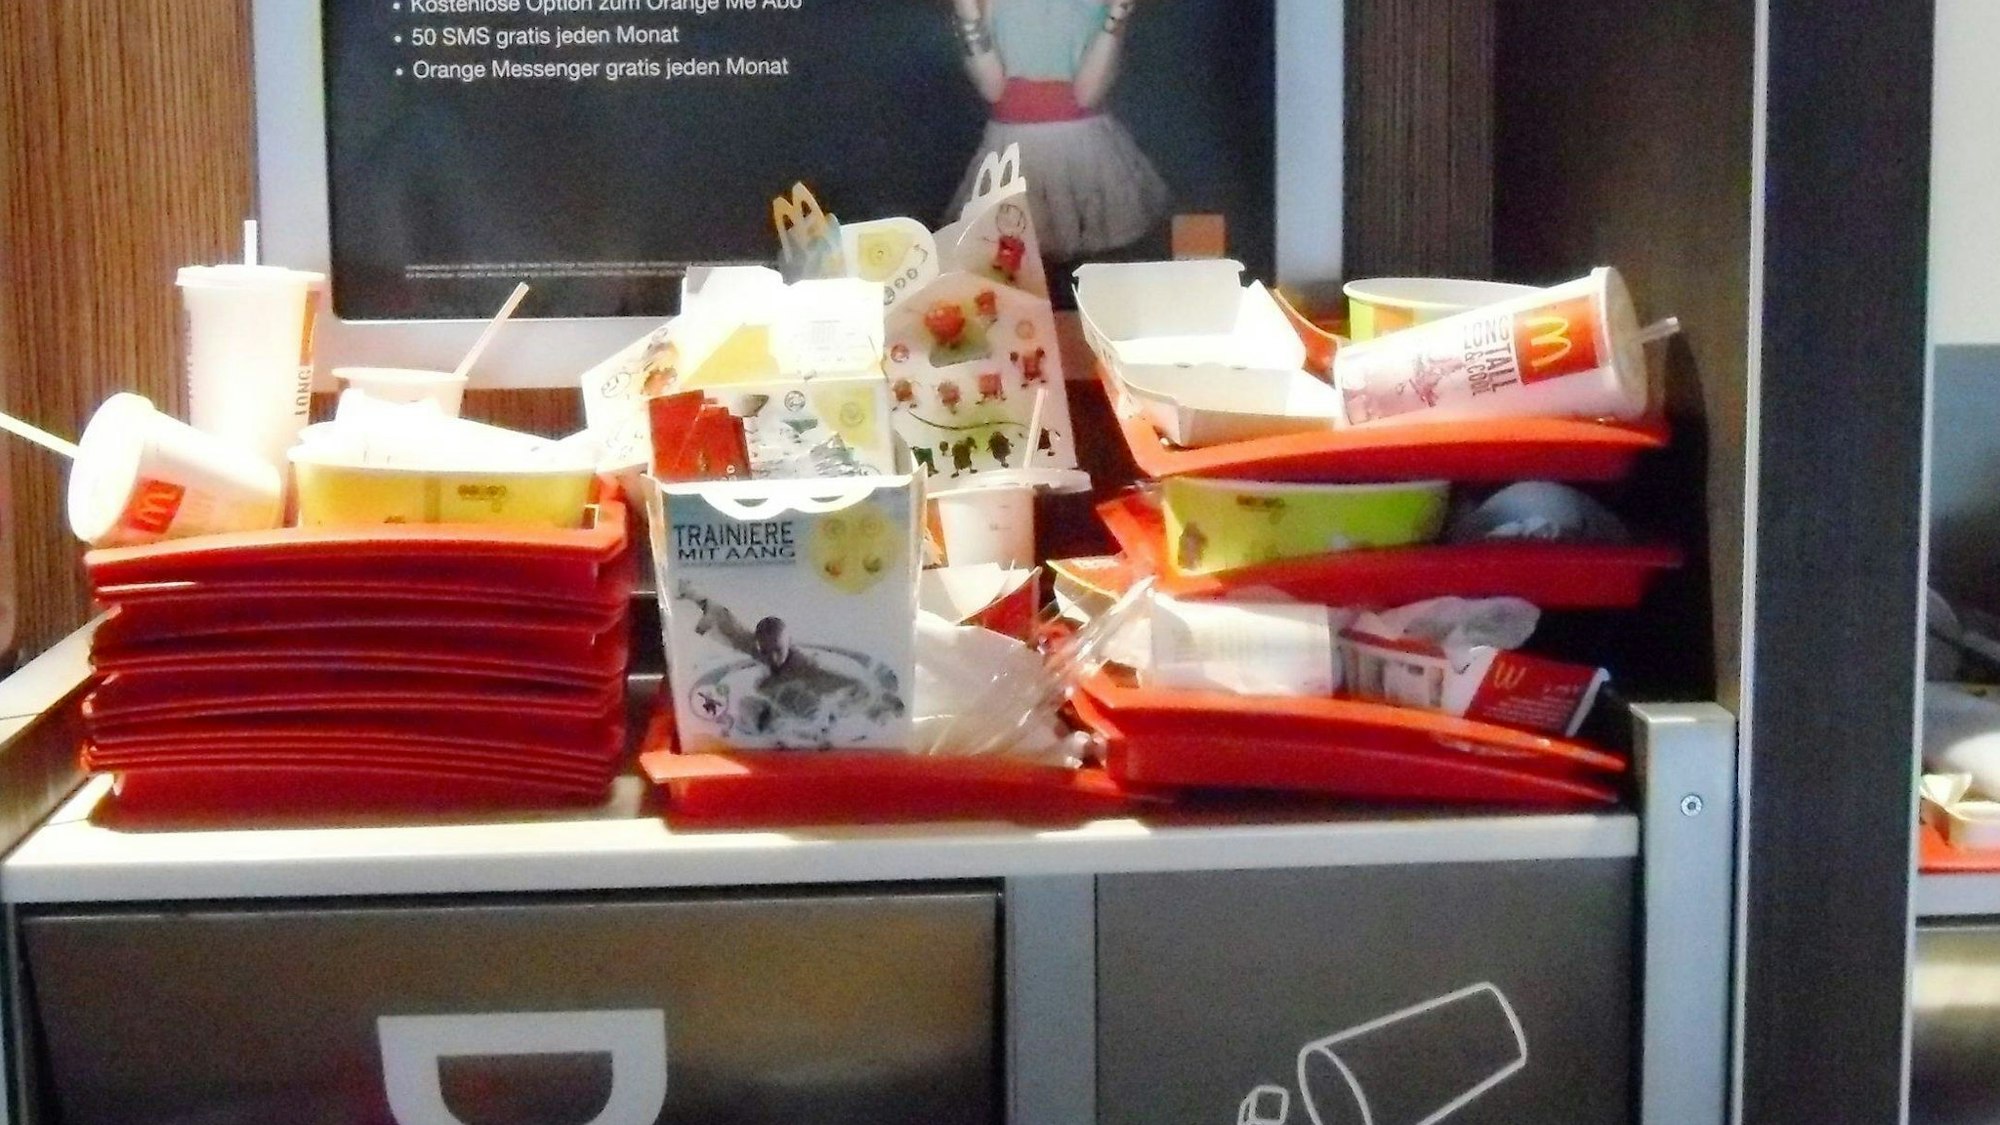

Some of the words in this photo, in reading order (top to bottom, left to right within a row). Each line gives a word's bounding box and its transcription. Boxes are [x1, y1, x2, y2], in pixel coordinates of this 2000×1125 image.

[411, 0, 520, 13] Kostenlose
[526, 0, 593, 15] Option
[599, 0, 640, 11] zum
[648, 0, 719, 14] Orange
[411, 28, 437, 46] 50
[442, 27, 490, 46] SMS
[496, 26, 550, 49] gratis
[556, 26, 610, 48] jeden
[617, 25, 680, 44] Monat
[413, 60, 486, 82] Orange
[492, 59, 600, 81] Messenger
[606, 58, 661, 81] gratis
[666, 58, 720, 80] jeden
[726, 57, 789, 76] Monat
[1464, 314, 1509, 350] LONG
[1485, 342, 1518, 393] TALL
[673, 521, 794, 547] TRAINIERE
[678, 547, 719, 560] MIT
[725, 546, 796, 560] AANG
